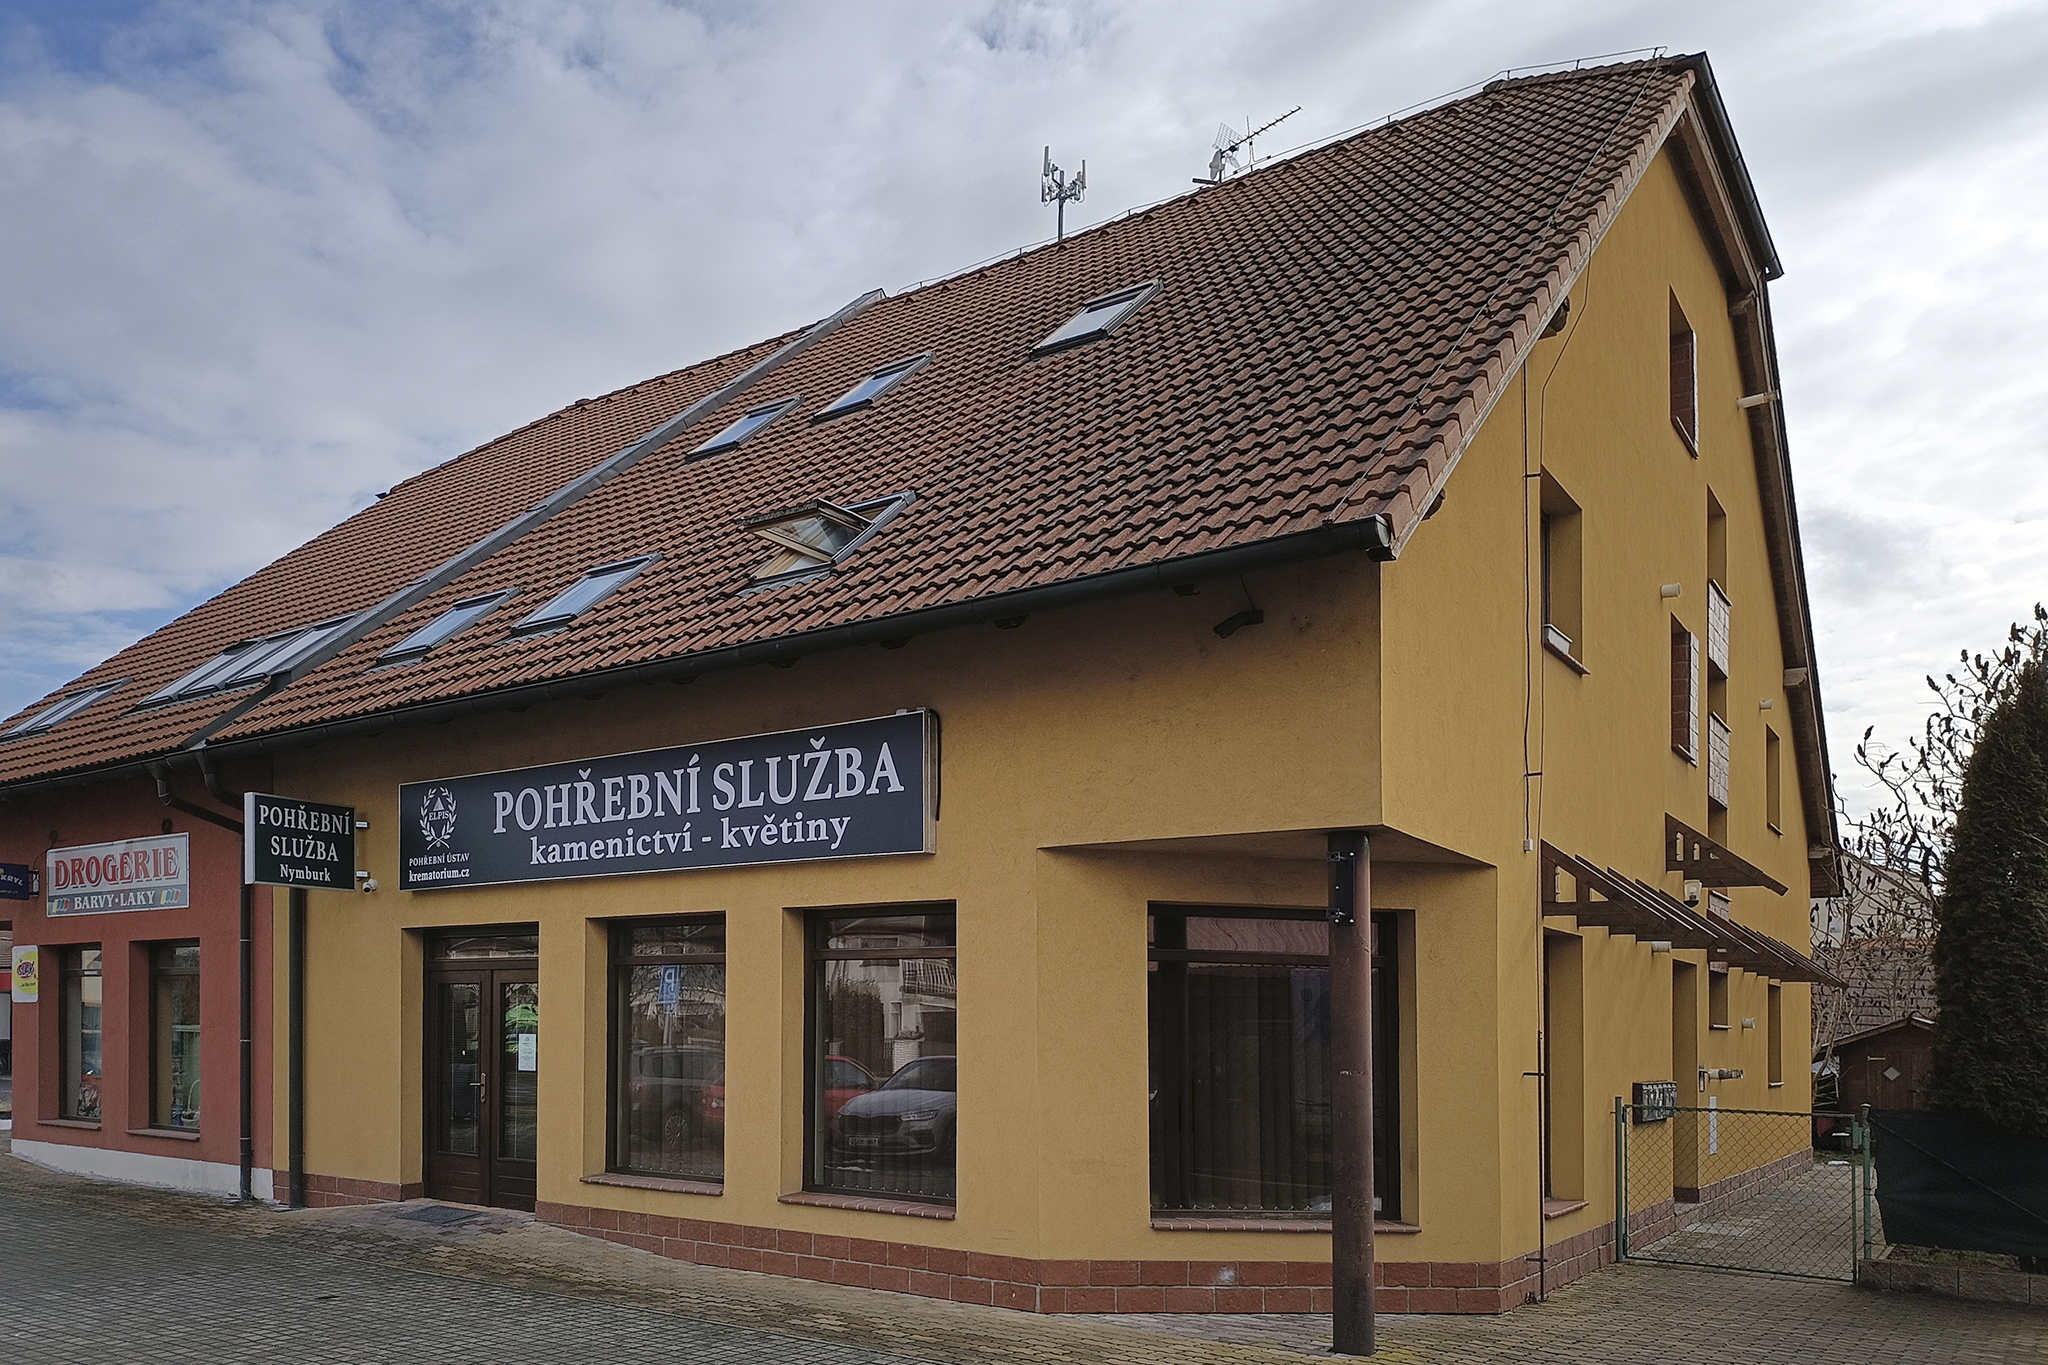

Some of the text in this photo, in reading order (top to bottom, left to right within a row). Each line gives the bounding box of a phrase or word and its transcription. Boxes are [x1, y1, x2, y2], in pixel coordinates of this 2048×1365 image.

[493, 736, 905, 834] POHŘEBNÍ SLUŽBA
[259, 804, 350, 835] POHŘEBNÍ
[428, 811, 450, 821] ELPIS
[271, 834, 339, 862] SLUŽBA
[530, 822, 693, 865] kamenictví
[720, 811, 851, 850] květiny
[54, 847, 178, 889] DROGERIE
[409, 852, 470, 867] POHŘEBNÍ ÚSTAV
[0, 874, 23, 886] KRYL
[280, 863, 331, 882] Nymburk
[408, 867, 470, 882] krematorium.cz
